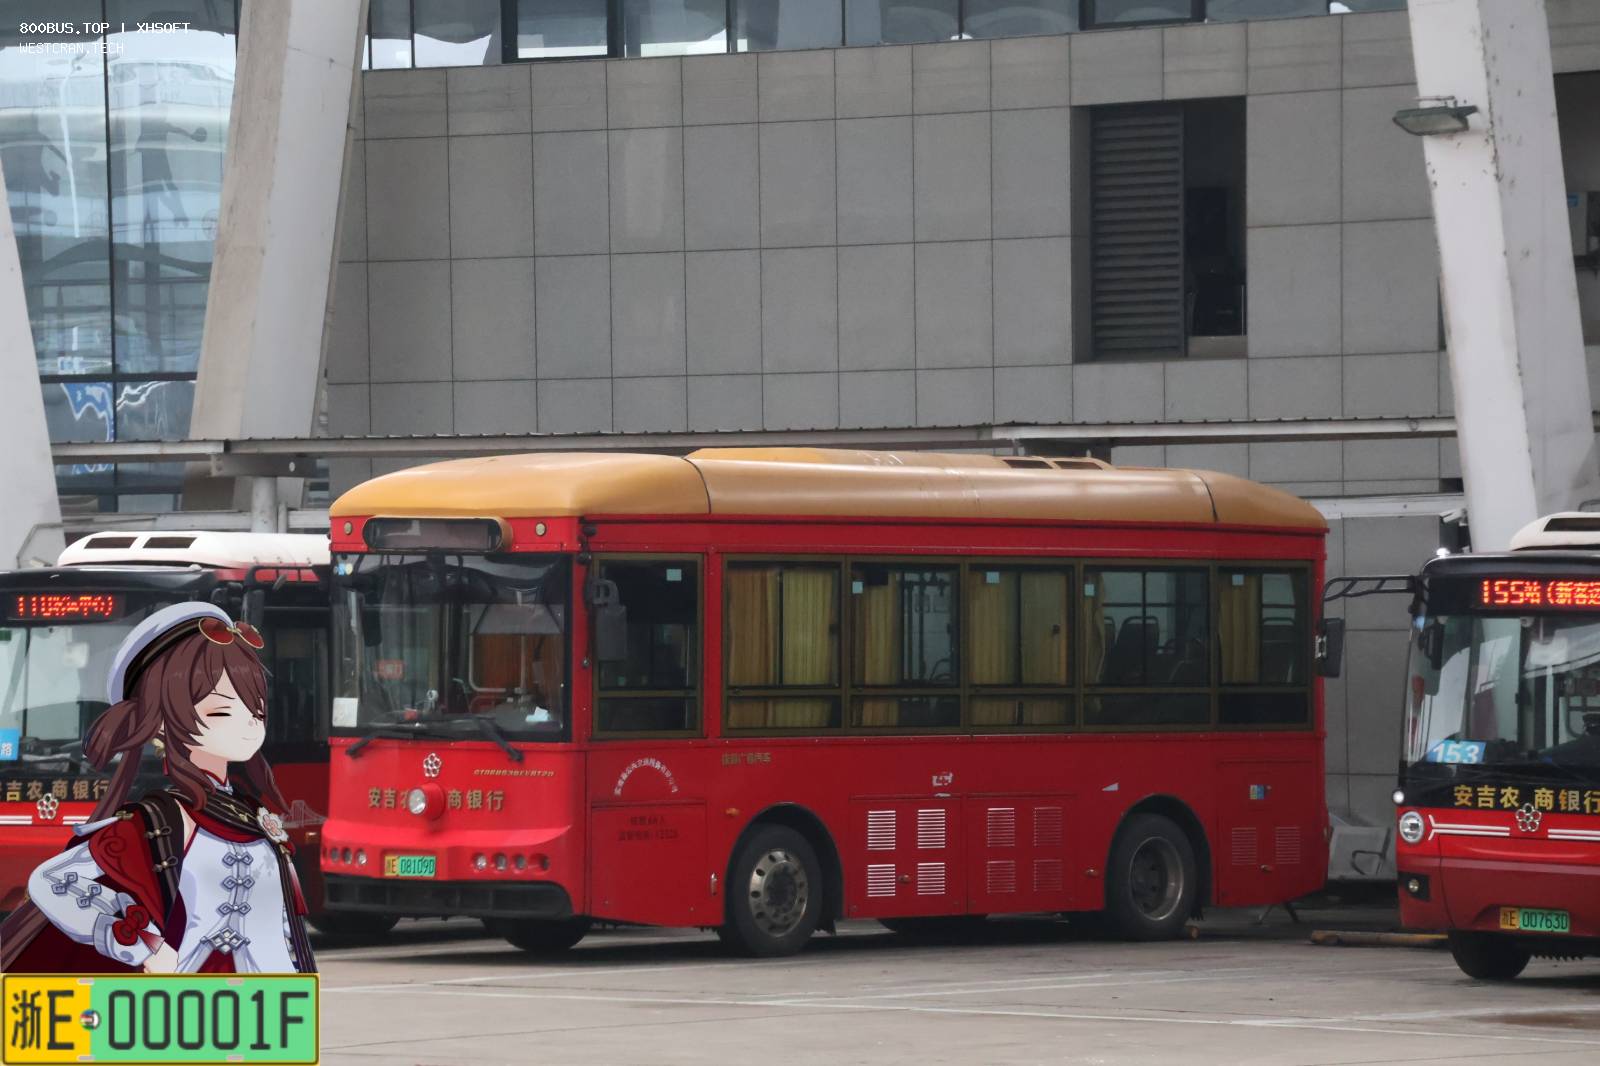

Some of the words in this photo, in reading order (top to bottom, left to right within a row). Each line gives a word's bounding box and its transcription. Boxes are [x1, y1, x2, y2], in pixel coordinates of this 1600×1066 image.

[1431, 742, 1479, 764] 153
[0, 779, 109, 801] 吉农商银行
[1453, 784, 1600, 813] 安吉农商银行
